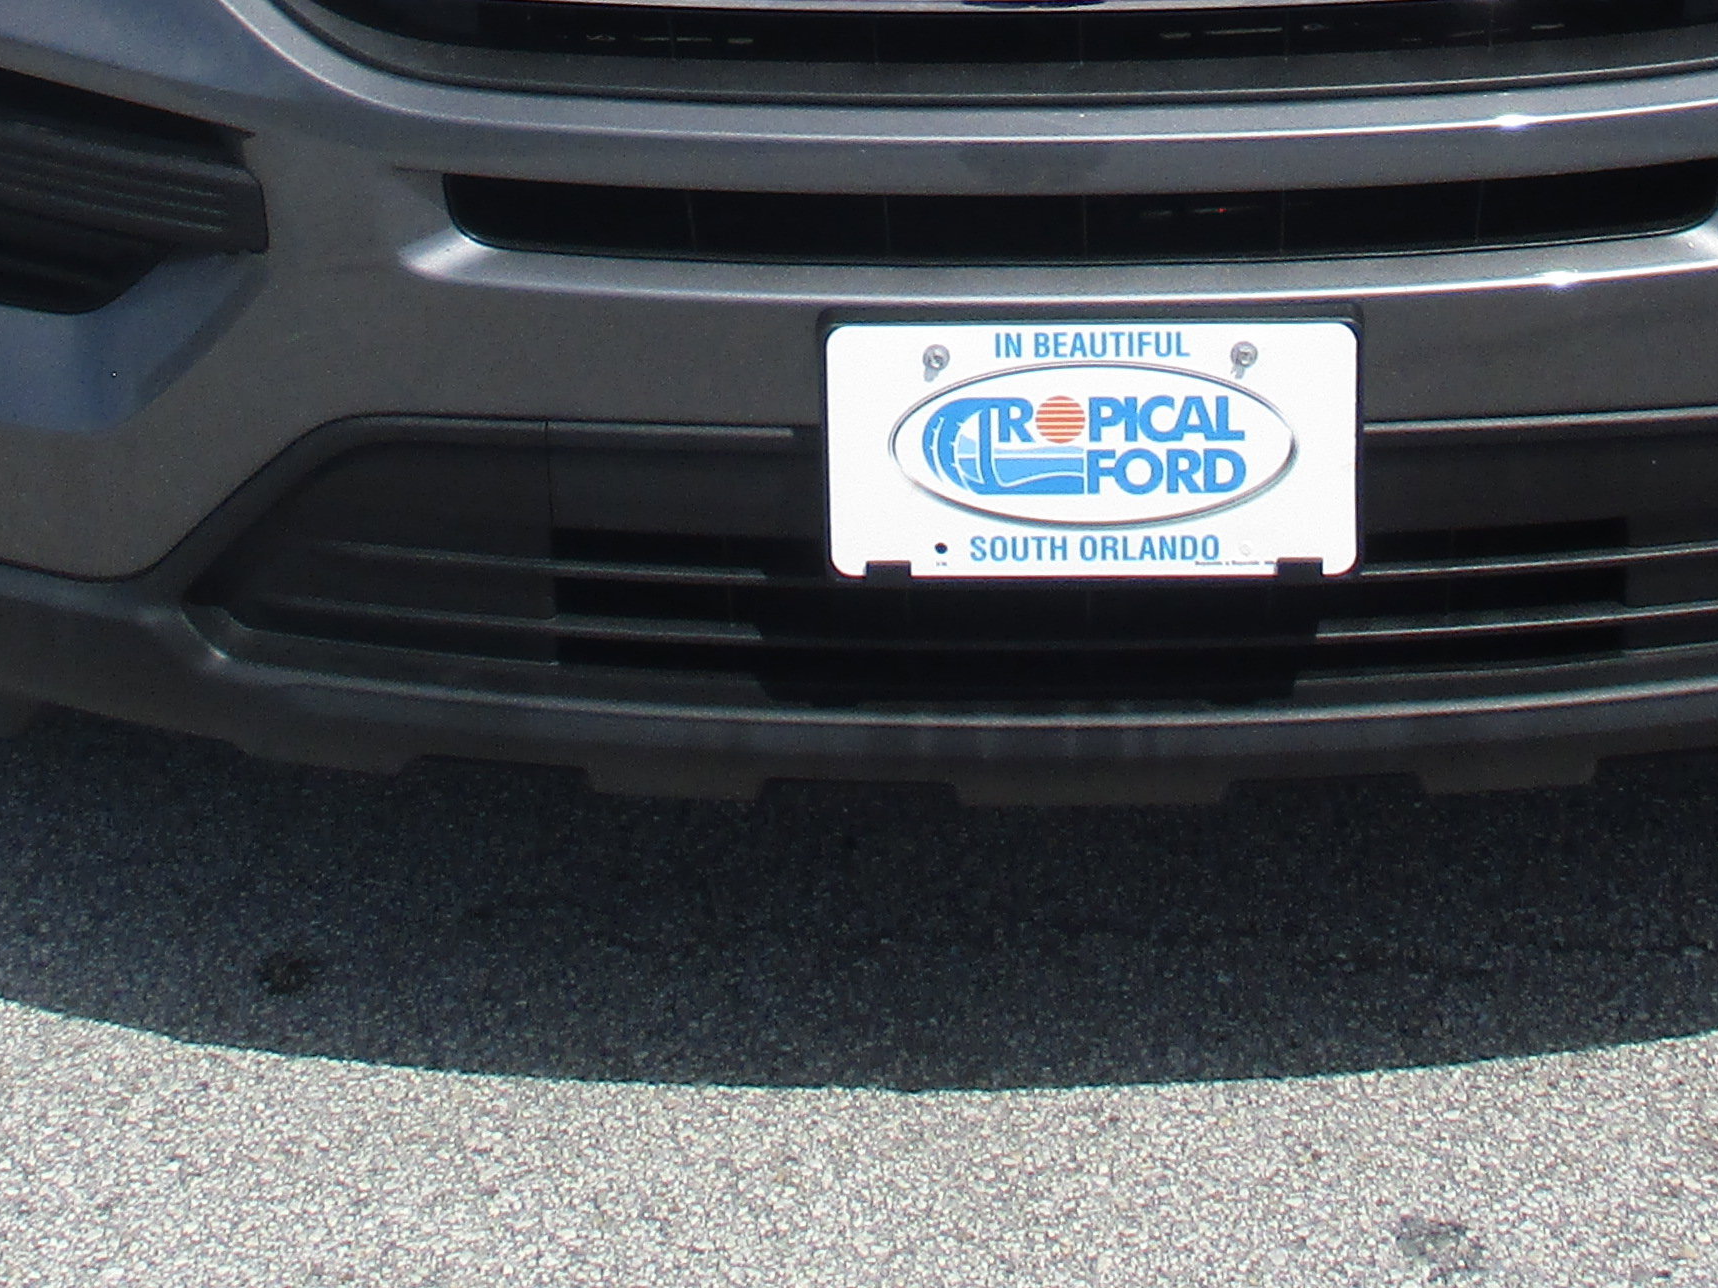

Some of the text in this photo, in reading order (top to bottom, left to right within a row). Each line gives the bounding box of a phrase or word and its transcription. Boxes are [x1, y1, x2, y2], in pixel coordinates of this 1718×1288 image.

[994, 331, 1191, 359] IN BEAUTIFUL
[1086, 448, 1247, 495] FORD
[969, 534, 1221, 562] SOUTH ORLANDO
